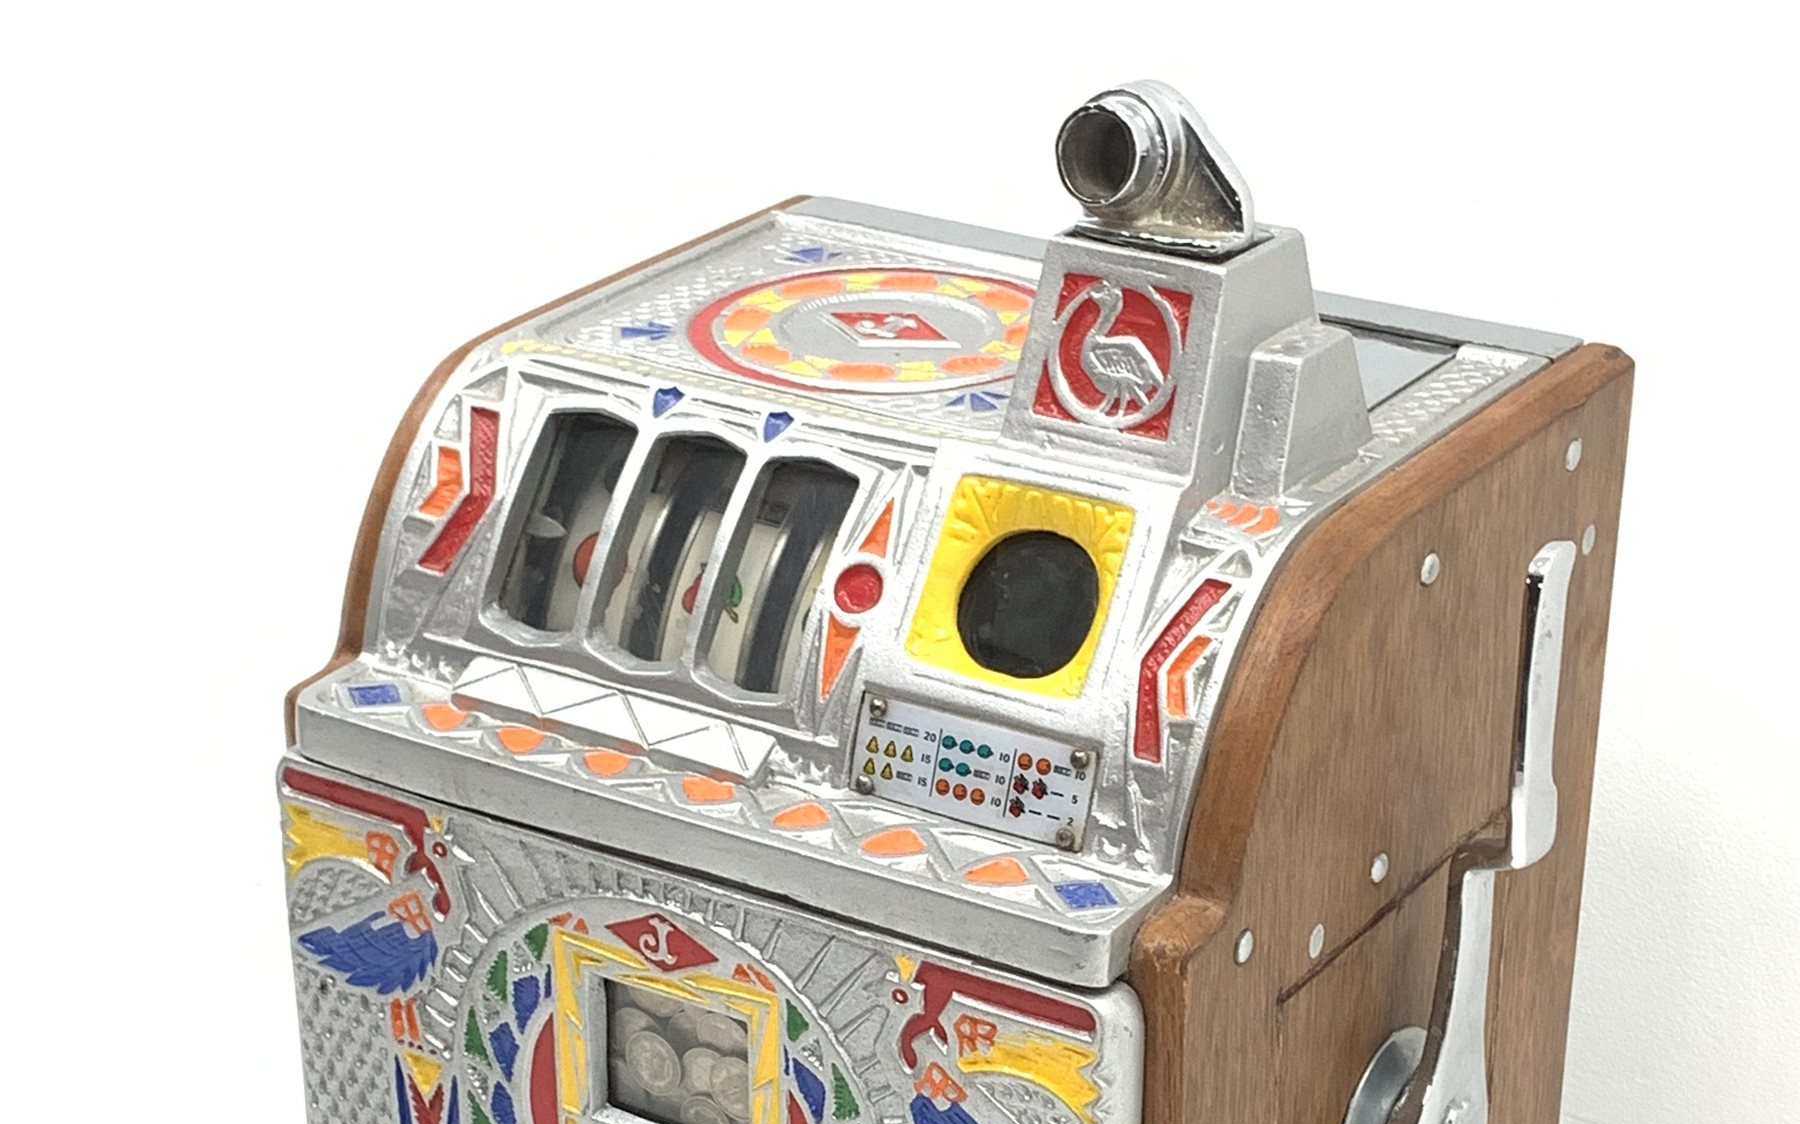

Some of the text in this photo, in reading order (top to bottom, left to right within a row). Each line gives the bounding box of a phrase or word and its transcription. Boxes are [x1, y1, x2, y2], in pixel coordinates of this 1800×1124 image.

[923, 731, 937, 743] 20
[920, 753, 931, 764] 15
[999, 752, 1011, 763] 10
[995, 774, 1006, 786] 10
[1074, 769, 1087, 781] 10
[917, 776, 928, 787] 15
[991, 797, 1002, 808] 10
[1071, 794, 1078, 805] 5
[1067, 817, 1074, 827] 2
[639, 917, 677, 965] J
